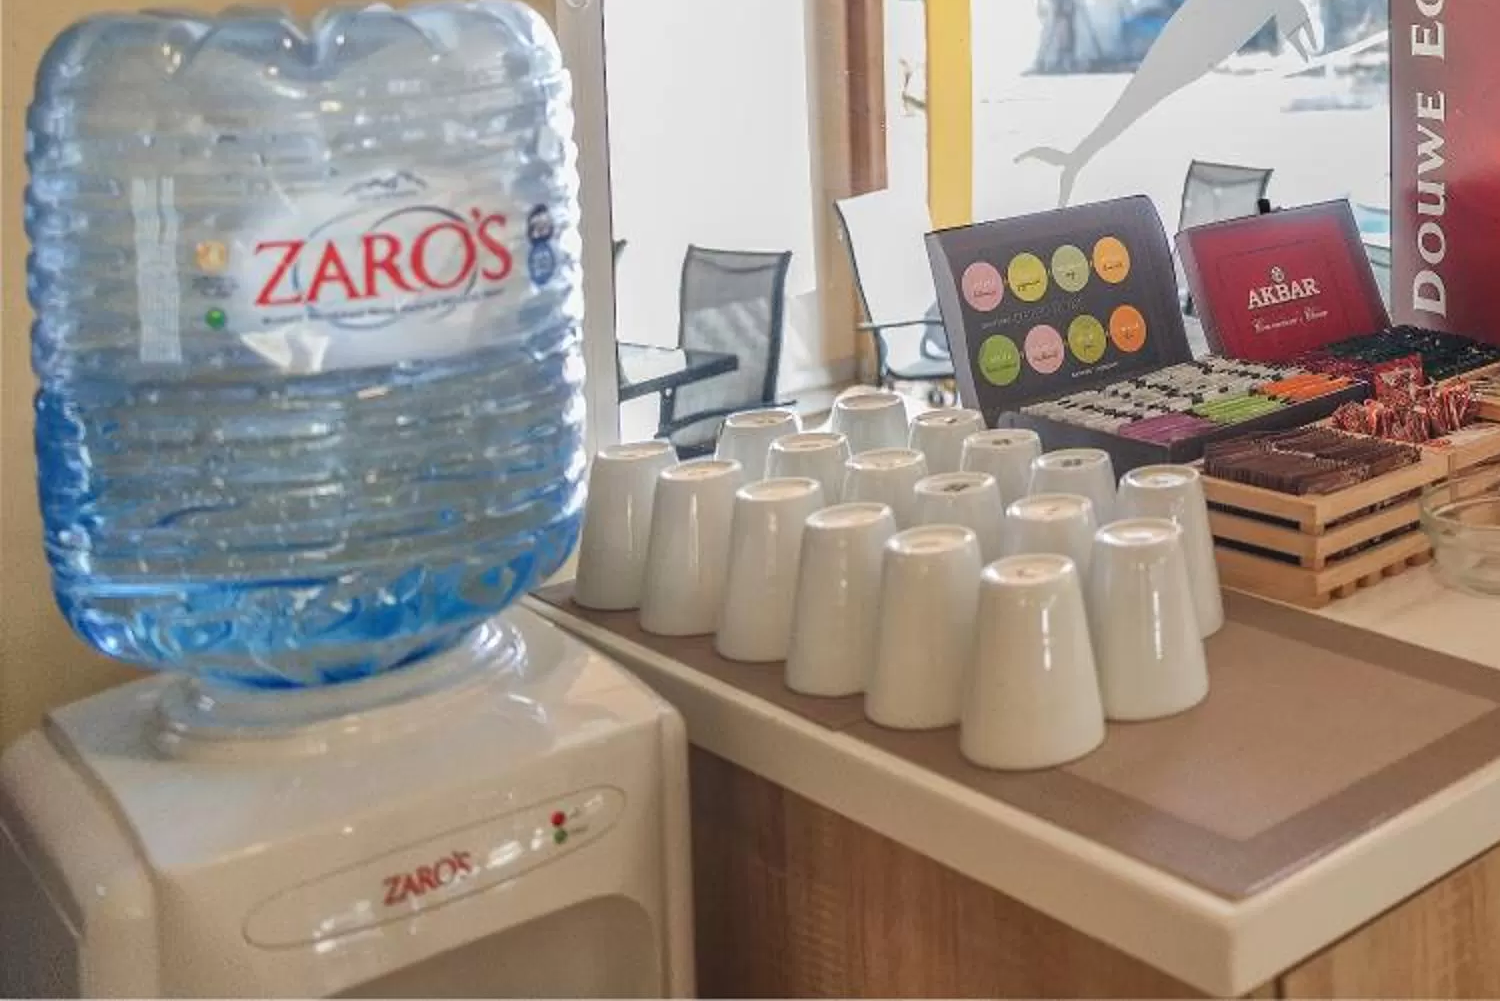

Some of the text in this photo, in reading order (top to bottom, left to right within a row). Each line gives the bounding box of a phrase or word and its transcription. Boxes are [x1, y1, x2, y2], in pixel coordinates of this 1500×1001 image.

[1413, 90, 1447, 318] DOUWE
[254, 207, 513, 306] ZARO'S
[1247, 278, 1321, 310] AKBAR
